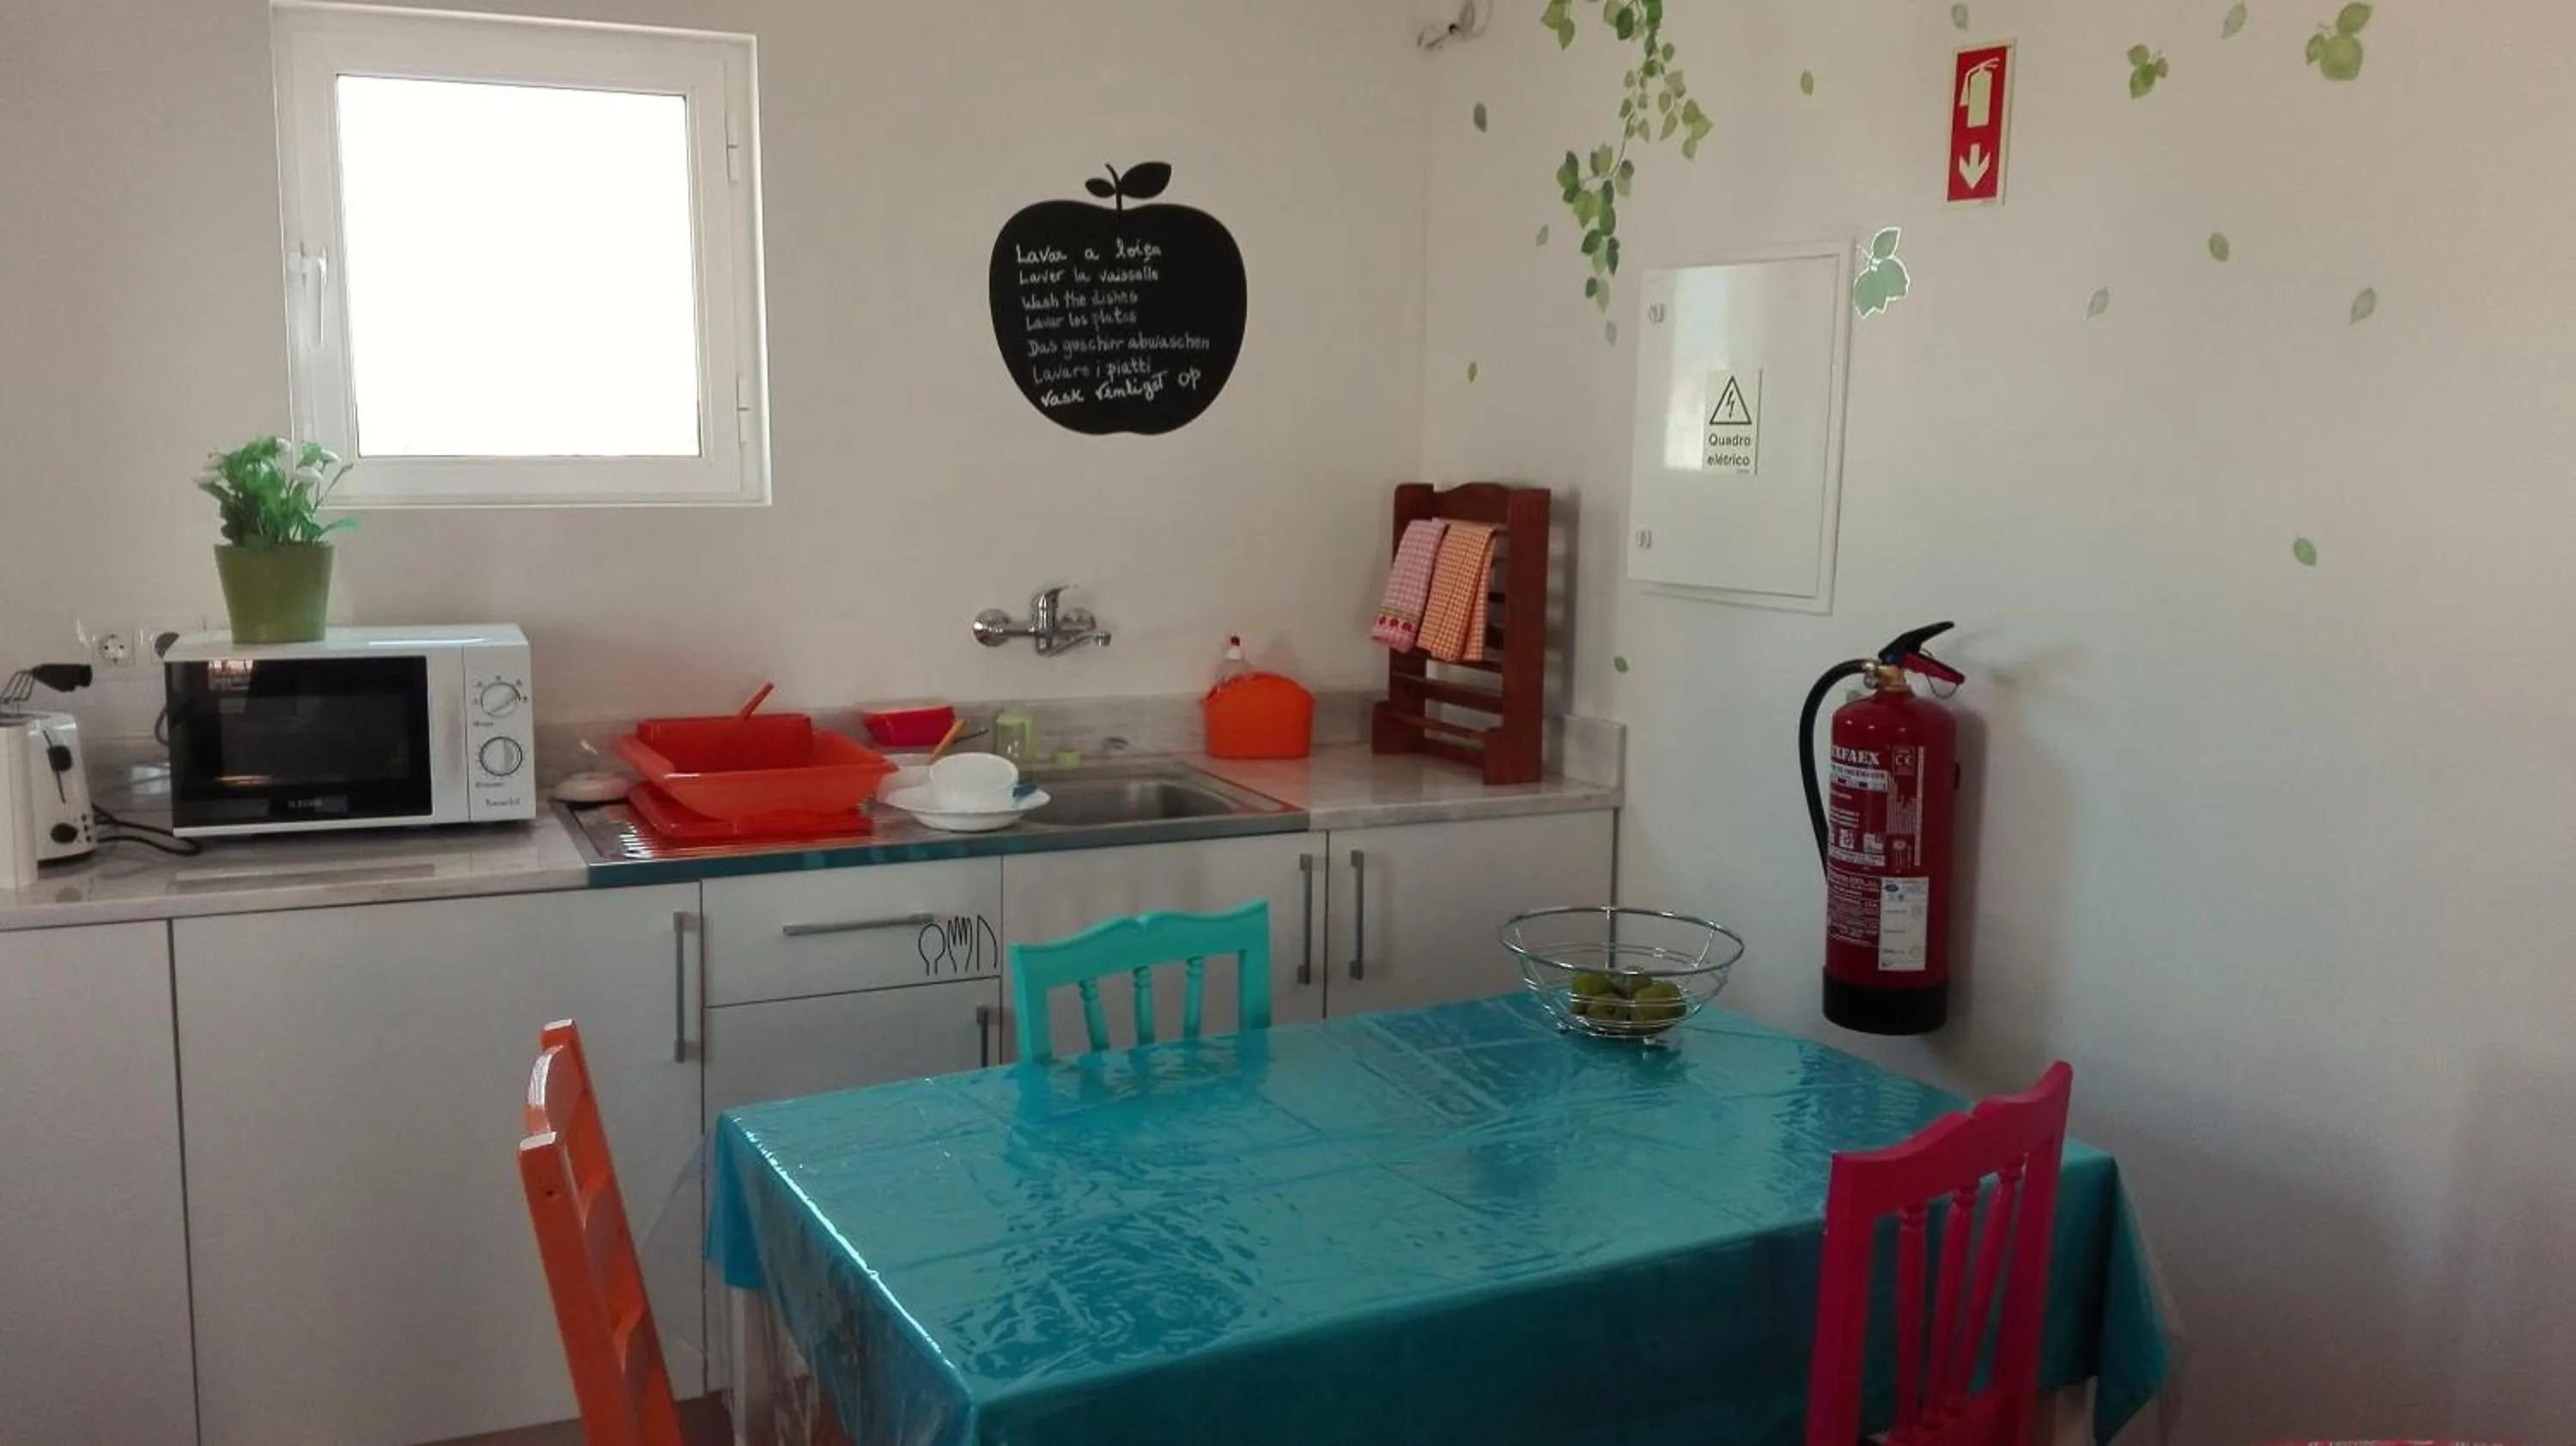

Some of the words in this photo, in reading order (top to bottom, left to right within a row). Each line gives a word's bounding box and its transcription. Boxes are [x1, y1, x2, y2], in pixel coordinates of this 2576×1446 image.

[1084, 248, 1100, 261] a
[1018, 269, 1066, 285] Laver
[1073, 266, 1091, 283] la
[1065, 289, 1087, 308] the
[1068, 312, 1089, 327] los
[1027, 340, 1058, 358] Das
[1096, 360, 1101, 378] i
[1708, 433, 1751, 447] Quadro
[1706, 452, 1750, 466] elétrico
